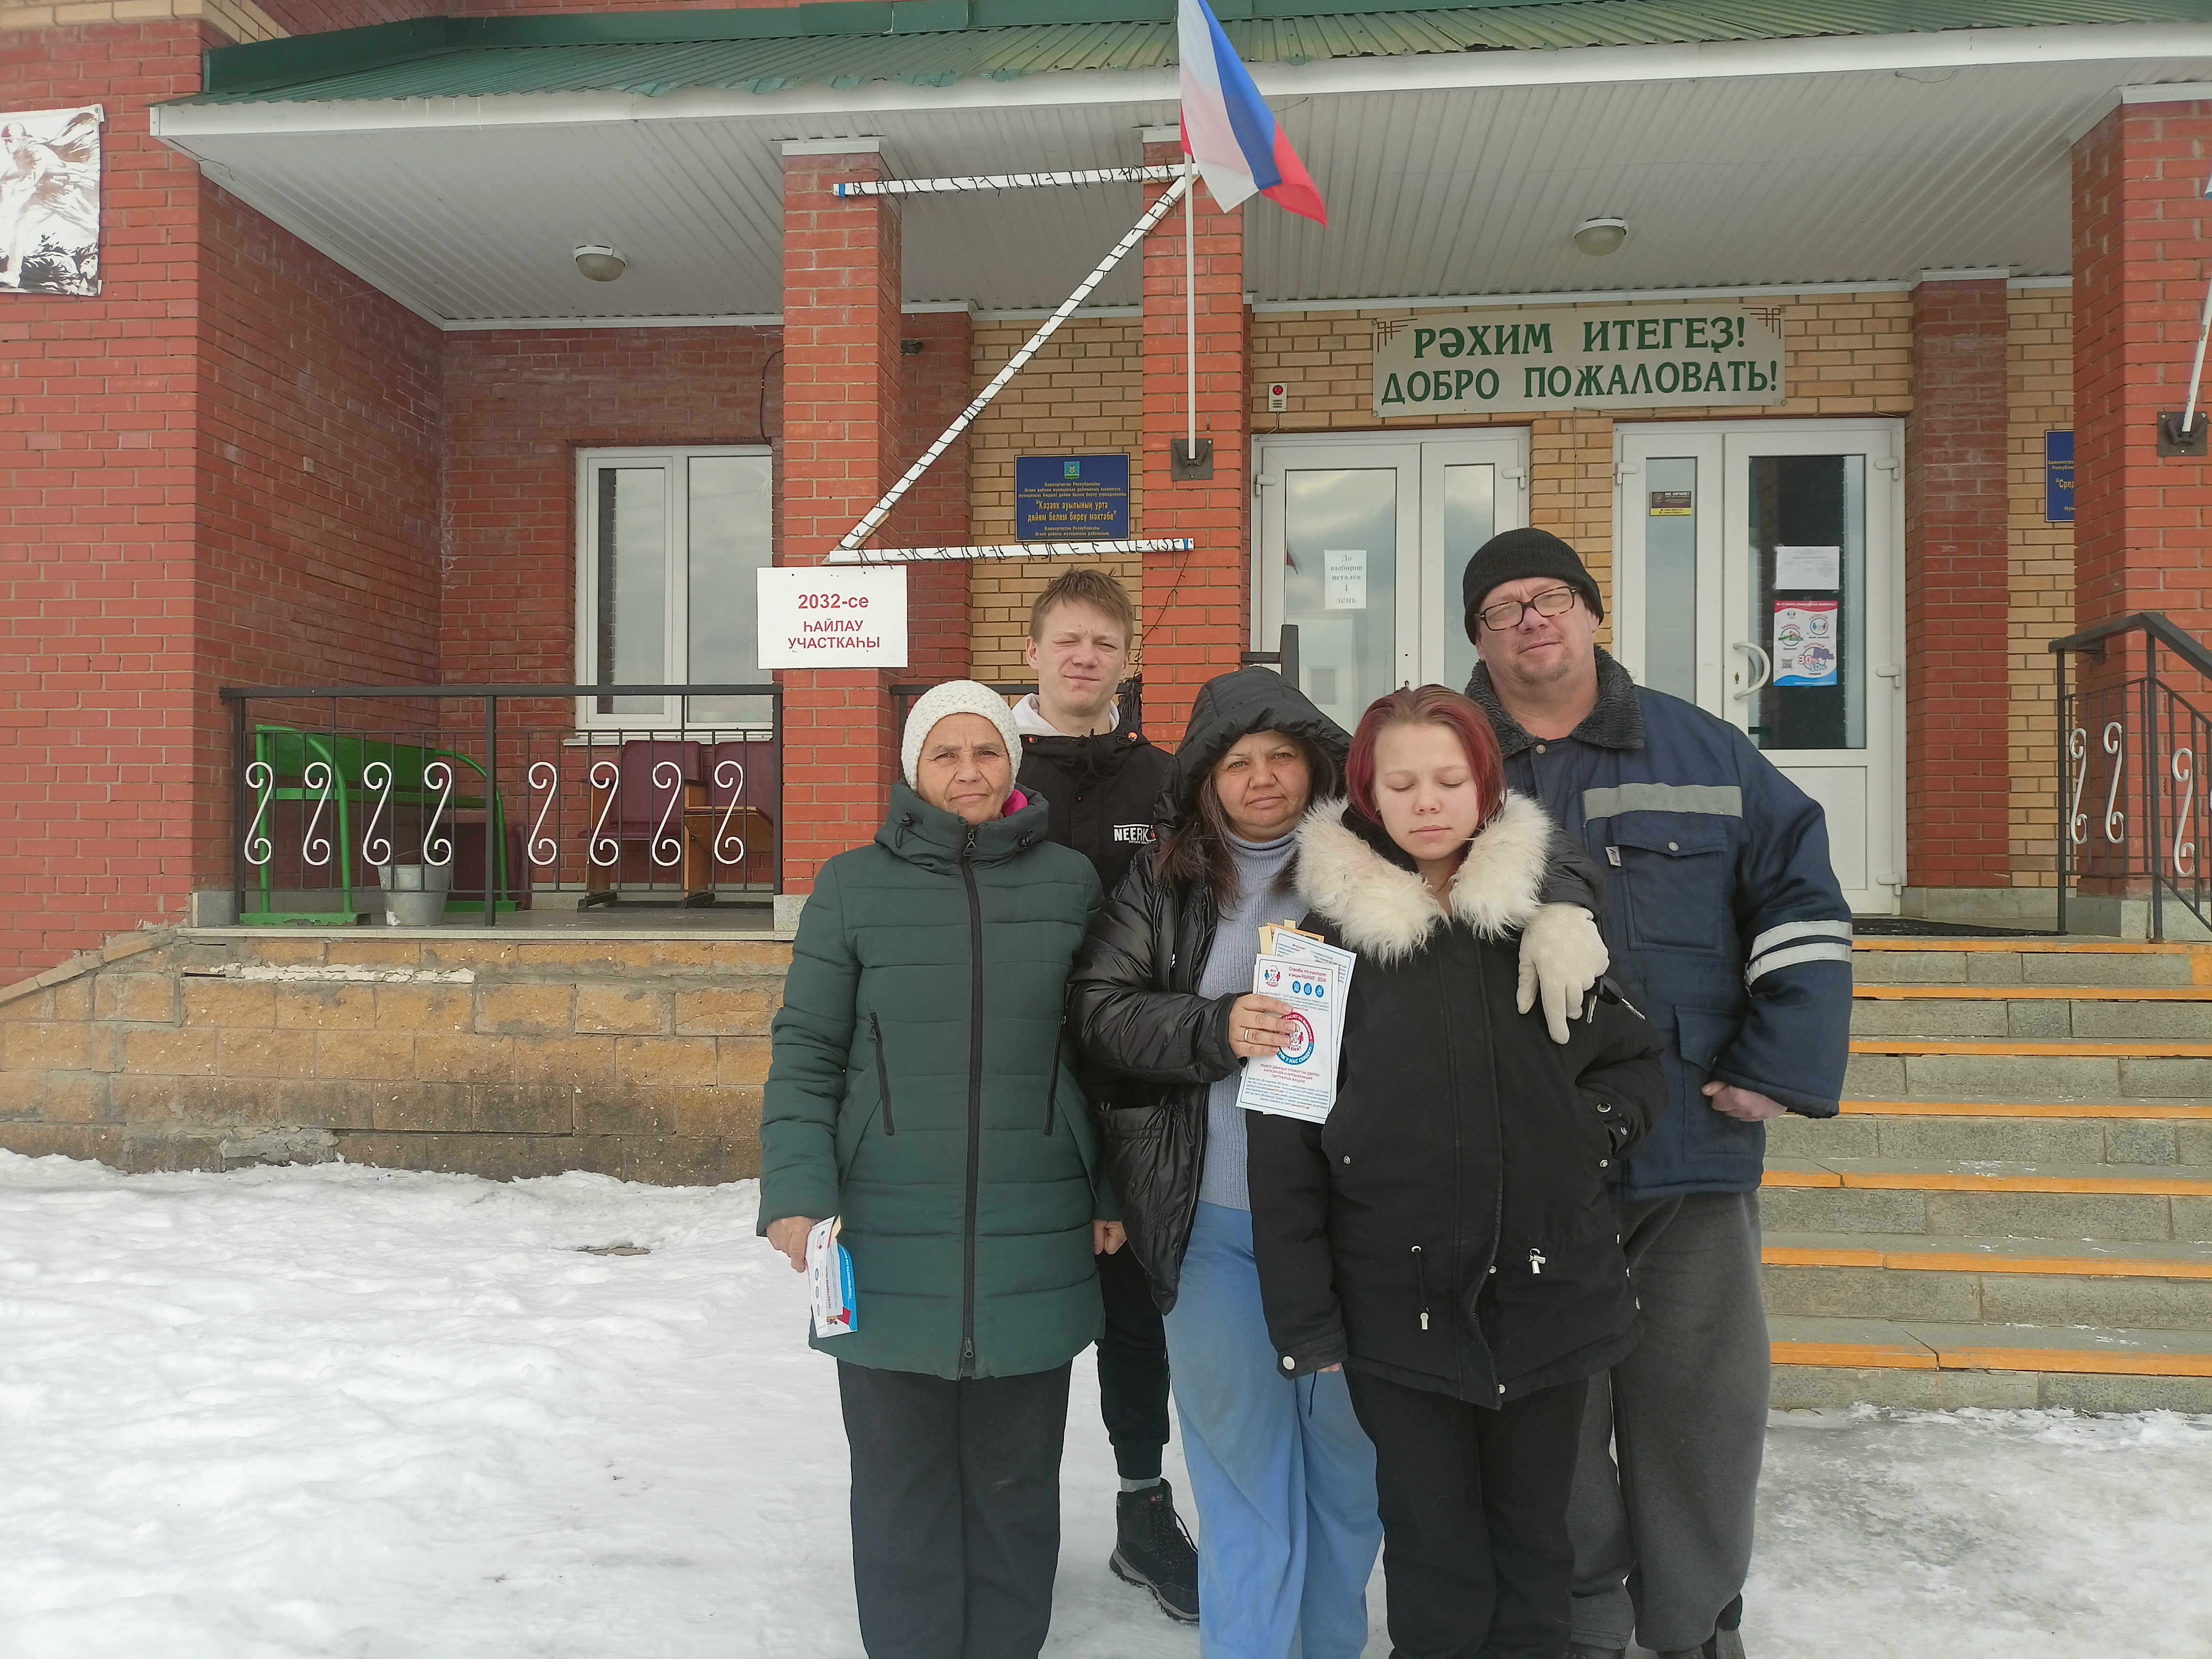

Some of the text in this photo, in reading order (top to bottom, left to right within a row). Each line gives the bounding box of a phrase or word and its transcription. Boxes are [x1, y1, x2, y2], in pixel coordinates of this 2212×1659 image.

[1414, 316, 1745, 359] РӘХИМ ИТЕГЕҘ!
[1381, 360, 1778, 406] ДОБРО ПОЖАЛОВАТЬ!
[1095, 502, 1108, 510] урта
[1049, 511, 1067, 521] белем
[798, 593, 869, 609] 2032-се
[1798, 654, 1819, 664] 30%
